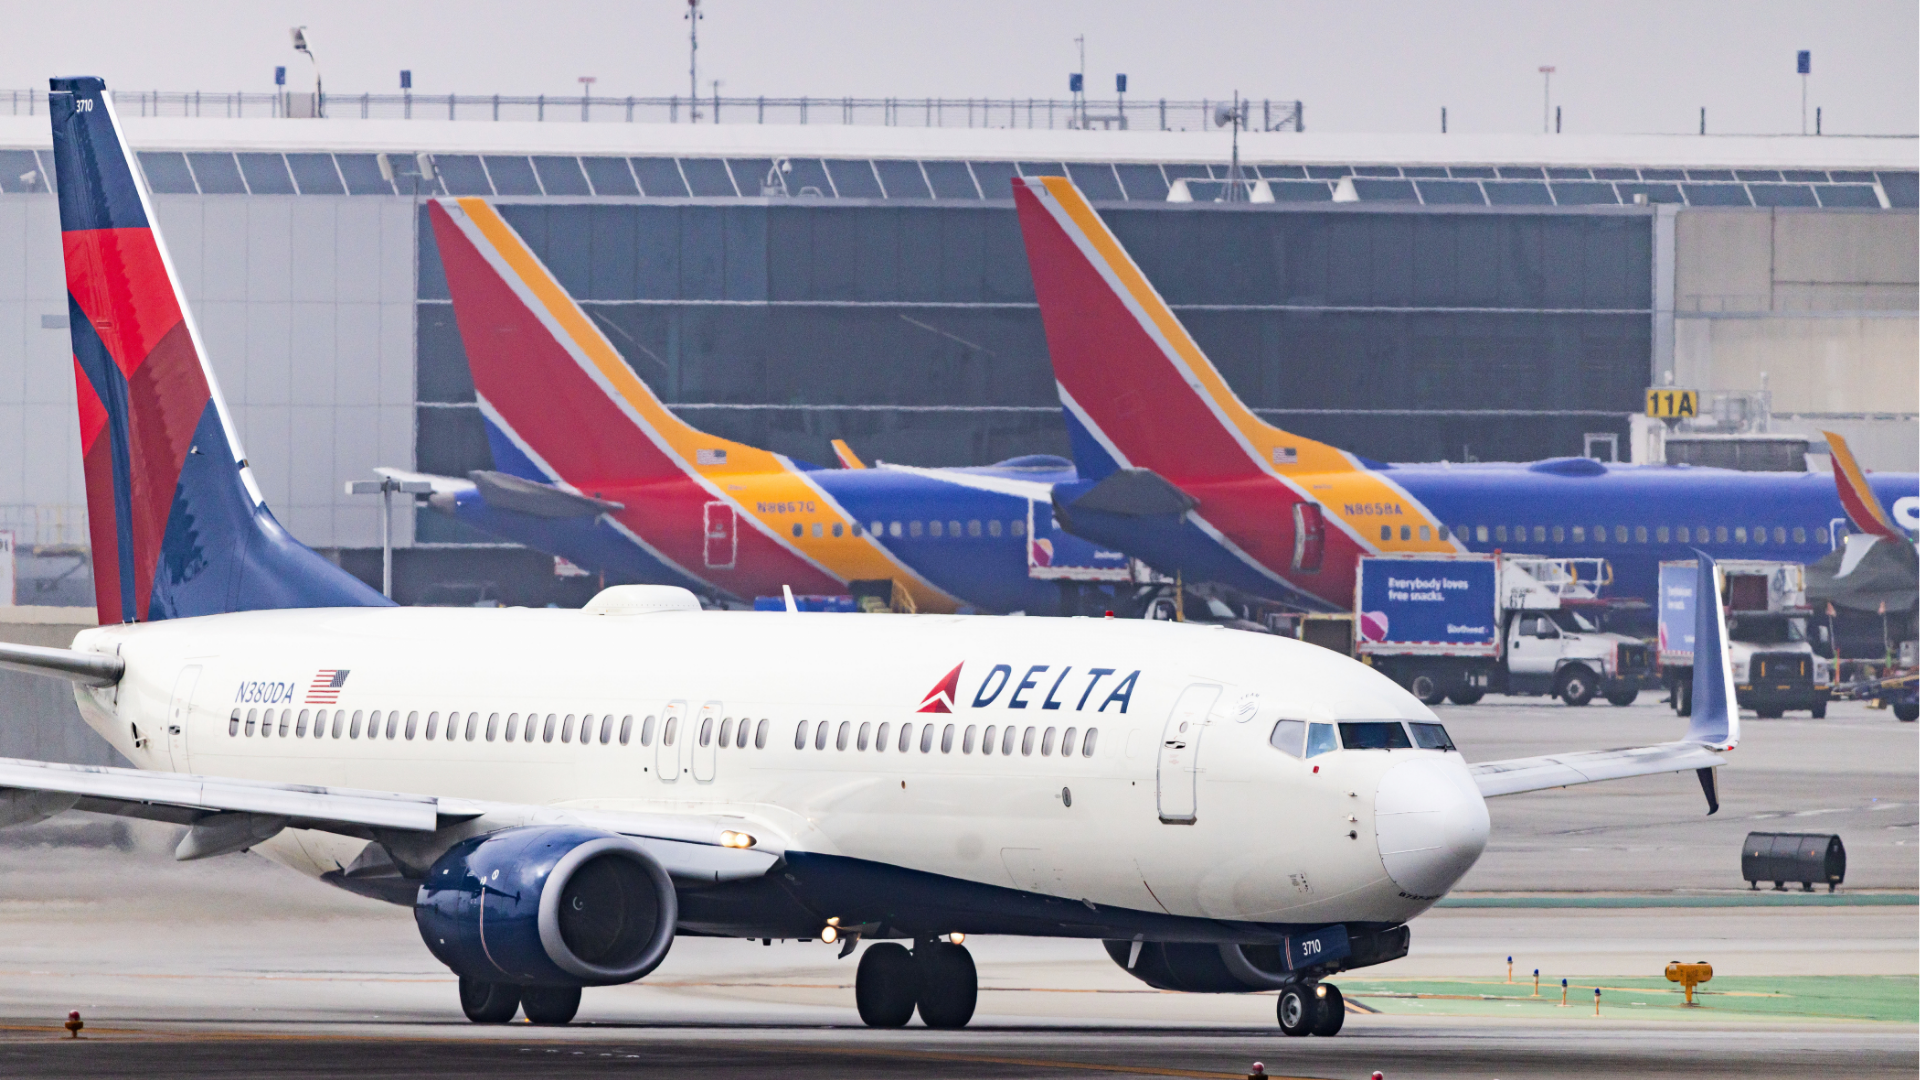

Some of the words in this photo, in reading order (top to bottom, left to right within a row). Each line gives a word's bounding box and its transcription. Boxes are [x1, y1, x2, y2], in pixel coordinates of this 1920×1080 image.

[76, 98, 93, 113] 3710
[1650, 392, 1693, 415] 11A
[1344, 502, 1403, 516] N8658A
[1388, 577, 1441, 591] Everybody
[1443, 577, 1469, 589] loves
[1388, 589, 1409, 601] free
[1410, 590, 1445, 601] snacks.
[234, 681, 296, 704] N380DA
[971, 663, 1141, 714] DELTA
[1301, 938, 1322, 956] 3710
